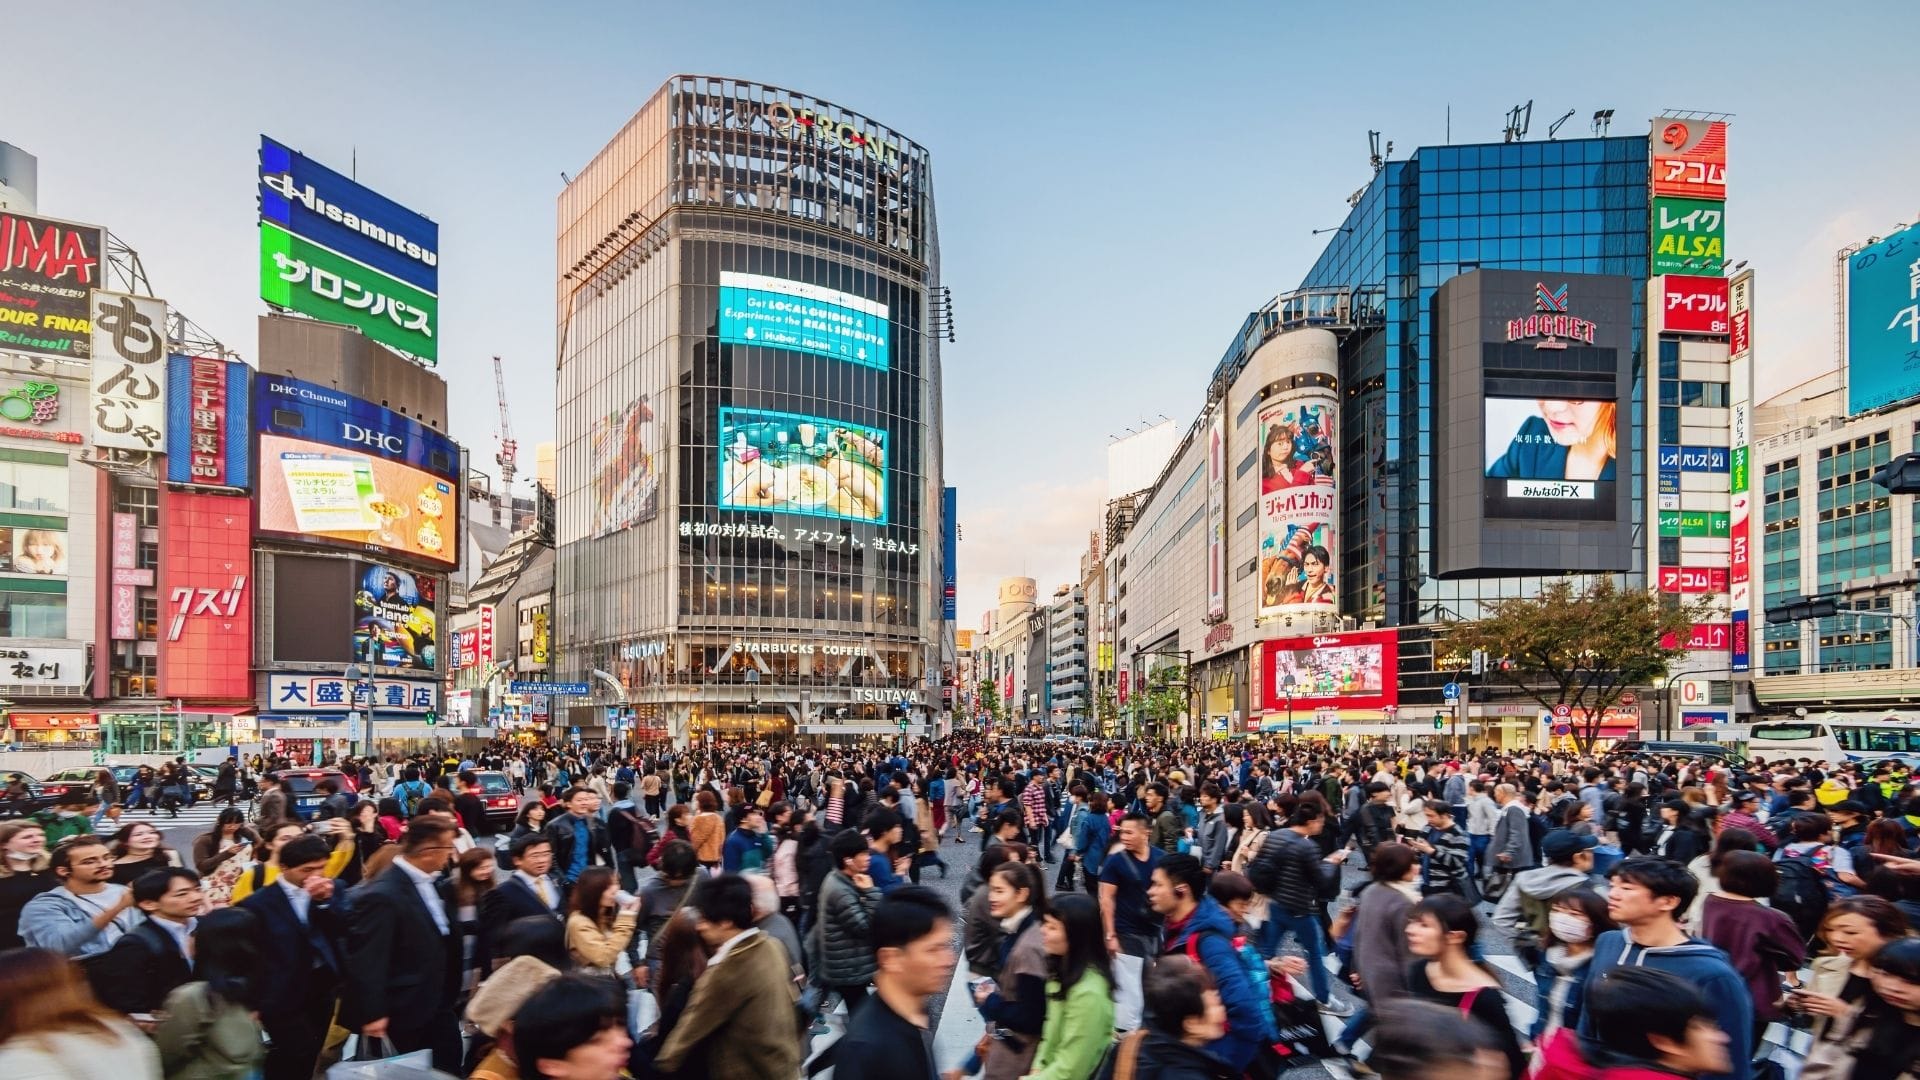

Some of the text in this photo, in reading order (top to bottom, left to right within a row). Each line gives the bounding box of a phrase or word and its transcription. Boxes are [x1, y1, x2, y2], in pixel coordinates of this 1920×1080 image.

[767, 101, 897, 165] QFRONT
[1664, 160, 1727, 185] アコム
[263, 174, 437, 266] Hisamitsu
[1660, 207, 1721, 232] レイク
[1657, 234, 1722, 258] ALSA
[273, 251, 432, 338] サロンパス
[1666, 292, 1727, 313] アイフル
[747, 297, 865, 329] Get LOCAL GUIDES &
[724, 307, 885, 347] Experience the REAL SHIBUYA
[1507, 314, 1597, 344] MAGNET
[1711, 320, 1727, 332] 8F
[1735, 321, 1746, 354] アイフル
[801, 335, 831, 351] Japan
[93, 297, 163, 448] もんじゃ
[270, 383, 347, 408] DHC Channel
[191, 361, 220, 478] 三千里薬品
[343, 423, 403, 454] DHC
[1661, 452, 1724, 468] レオパレス21
[1523, 485, 1580, 498] みんなのFX
[1659, 516, 1679, 527] レイク
[1681, 518, 1704, 527] ALSA
[1733, 536, 1746, 564] アコム
[1664, 572, 1708, 588] アコム
[167, 575, 247, 641] クスリ
[372, 606, 421, 625] Planets
[734, 641, 868, 657] STARBUCKS COFFEE
[1735, 620, 1746, 656] PROMISE
[10, 661, 60, 680] 松川
[280, 681, 432, 707] 大盛堂書店
[855, 688, 918, 703] TSUTAYA
